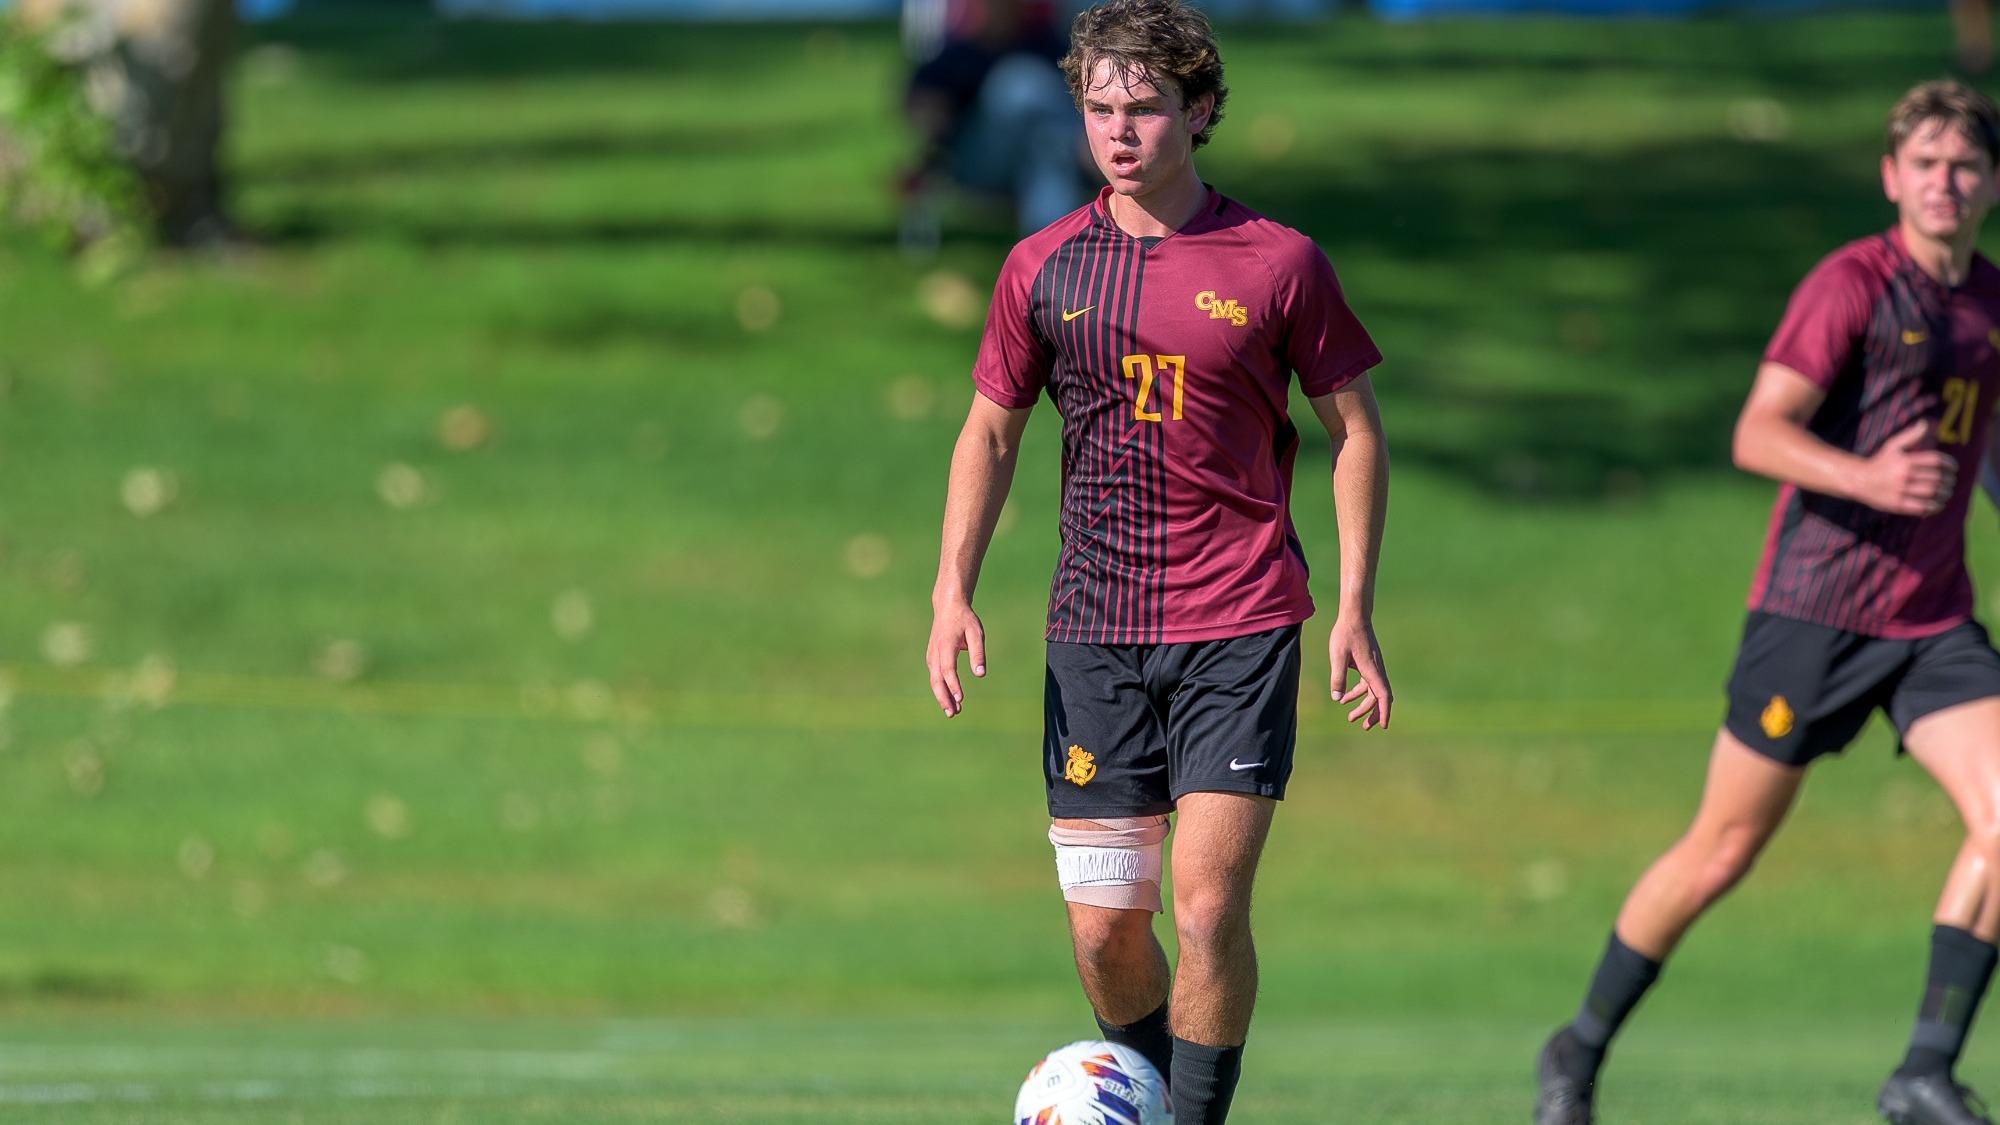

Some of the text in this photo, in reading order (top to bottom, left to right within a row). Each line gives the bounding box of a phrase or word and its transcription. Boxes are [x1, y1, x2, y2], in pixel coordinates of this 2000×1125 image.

[1194, 290, 1248, 327] CMS
[1121, 354, 1186, 422] 27
[1938, 378, 1979, 445] 21
